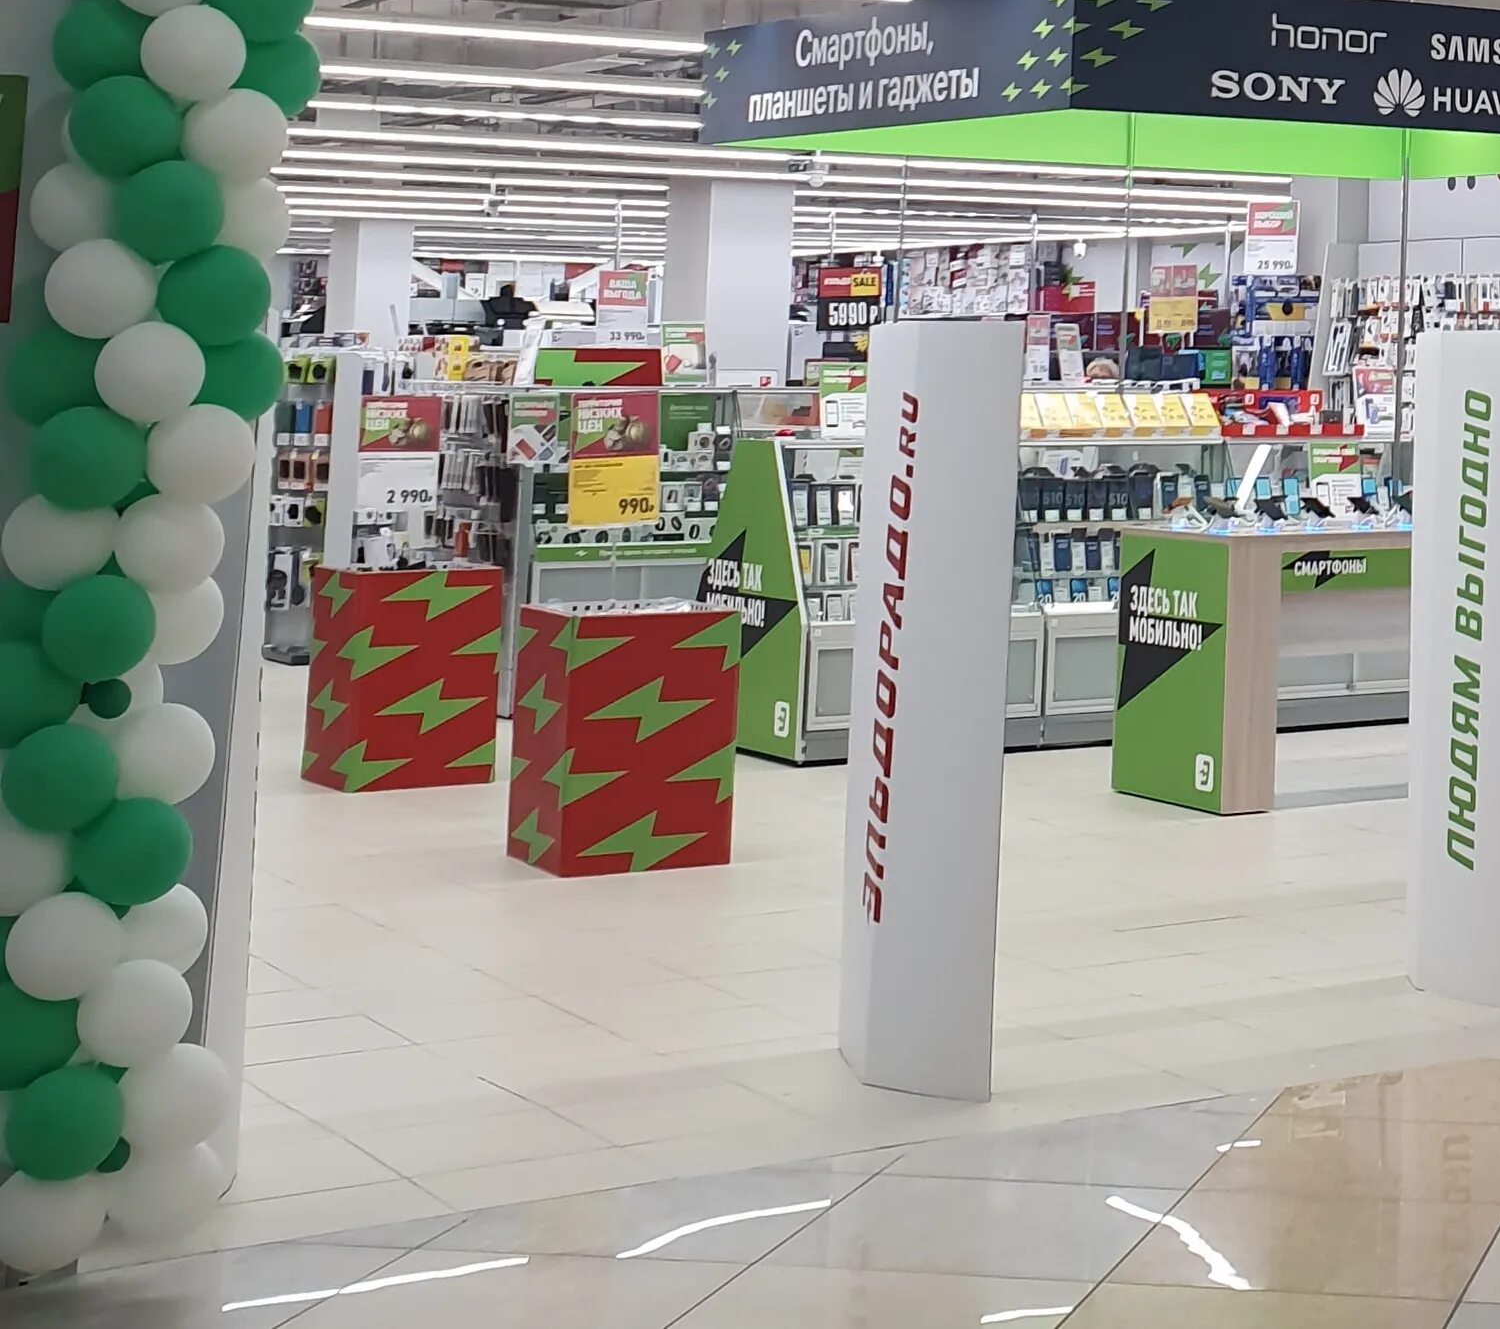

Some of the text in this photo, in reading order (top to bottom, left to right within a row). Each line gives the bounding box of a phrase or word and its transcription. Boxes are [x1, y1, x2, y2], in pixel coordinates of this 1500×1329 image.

[795, 16, 935, 70] Смартфоны,
[1271, 12, 1388, 55] honor
[747, 66, 980, 124] планшеты и гаджеты
[1210, 70, 1346, 105] SONY
[852, 276, 877, 287] SALE
[828, 301, 867, 327] 5990
[386, 489, 395, 504] 2
[707, 558, 763, 592] ЗДЕСЬ ТАК
[1294, 556, 1367, 577] СМАРТФОНЫ
[1129, 585, 1198, 619] ЗДЕСЬ ТАК
[1128, 615, 1203, 651] МОБИЛЬНО!
[1447, 388, 1492, 871] ЛЮДЯМ ВЫГОДНО
[862, 391, 920, 926] ЭЛЬДОРАДО.RU
